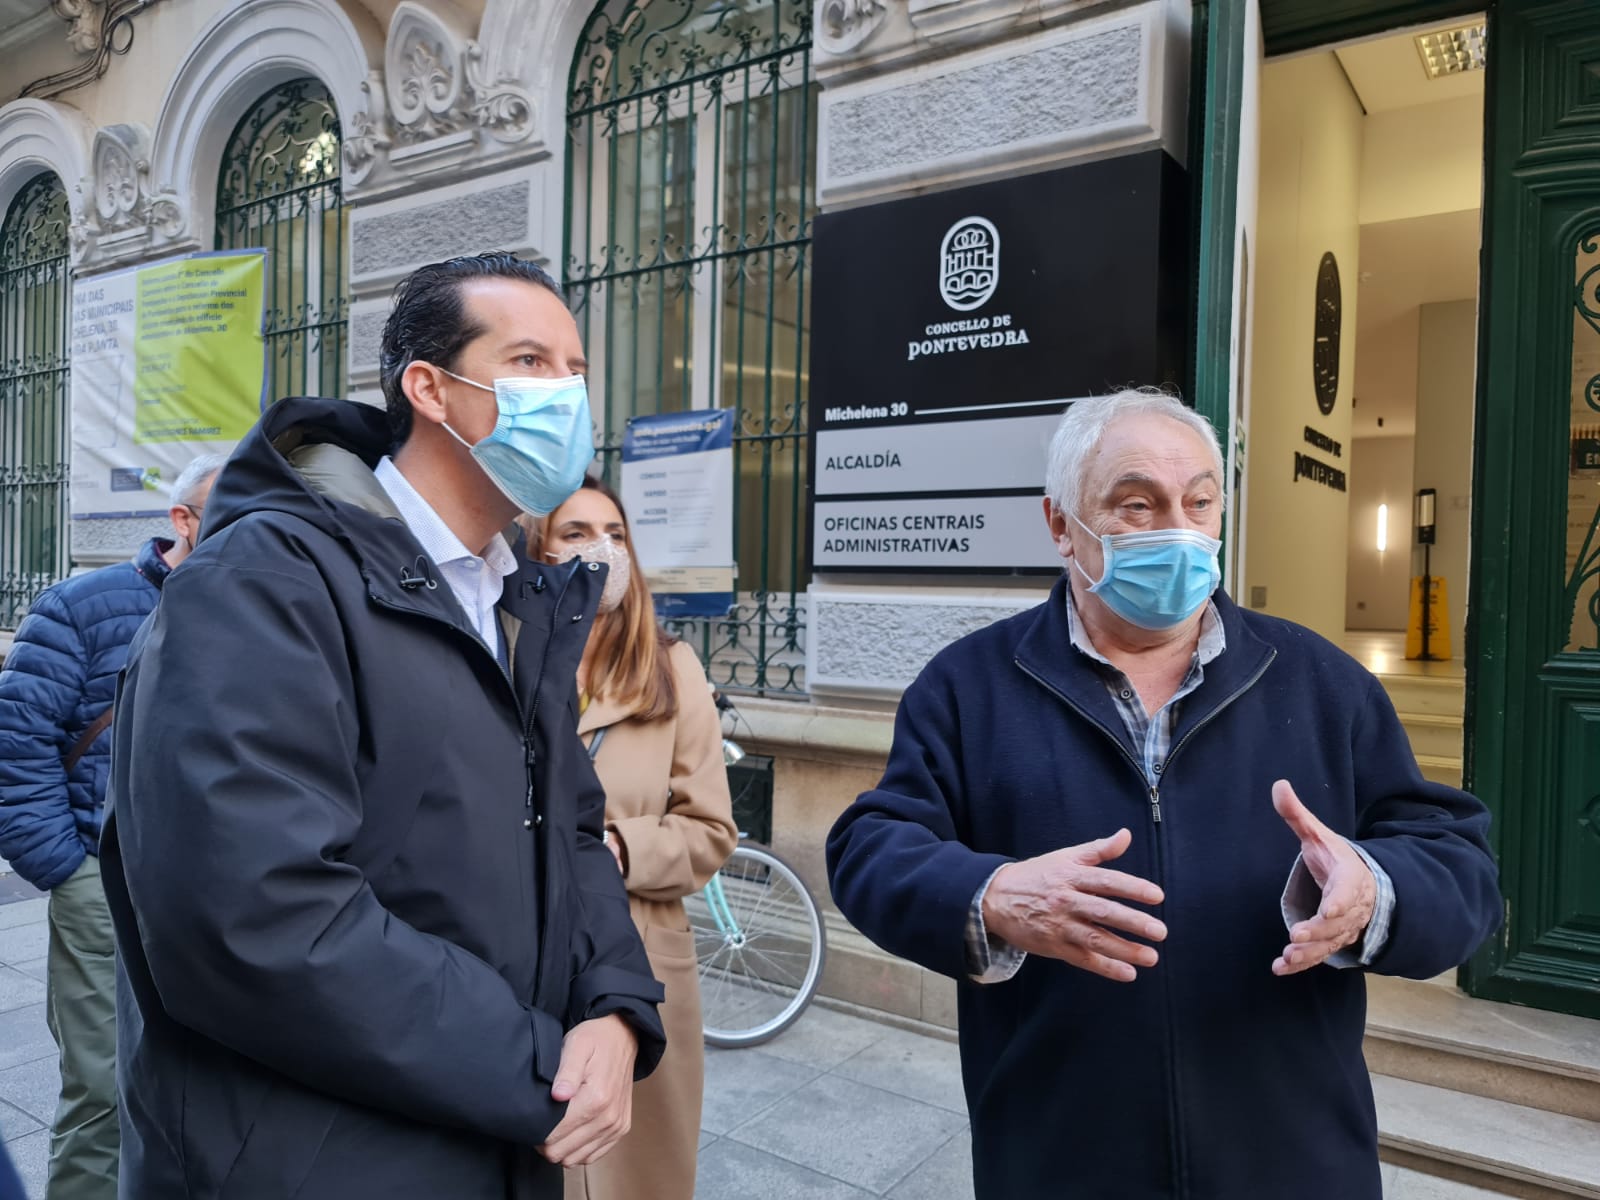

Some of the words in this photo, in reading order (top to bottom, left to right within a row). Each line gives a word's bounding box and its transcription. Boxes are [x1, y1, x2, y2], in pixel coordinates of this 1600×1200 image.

[925, 318, 990, 336] CONCELLO
[992, 314, 1012, 328] DE
[908, 329, 1030, 361] PONTEVEDRA
[825, 404, 888, 422] Michelena
[890, 402, 909, 417] 30
[825, 449, 902, 471] ALCALDÍA
[824, 516, 898, 532] OFICINAS
[902, 514, 985, 531] CENTRAIS
[823, 537, 970, 553] ADMINISTRATIVAS
